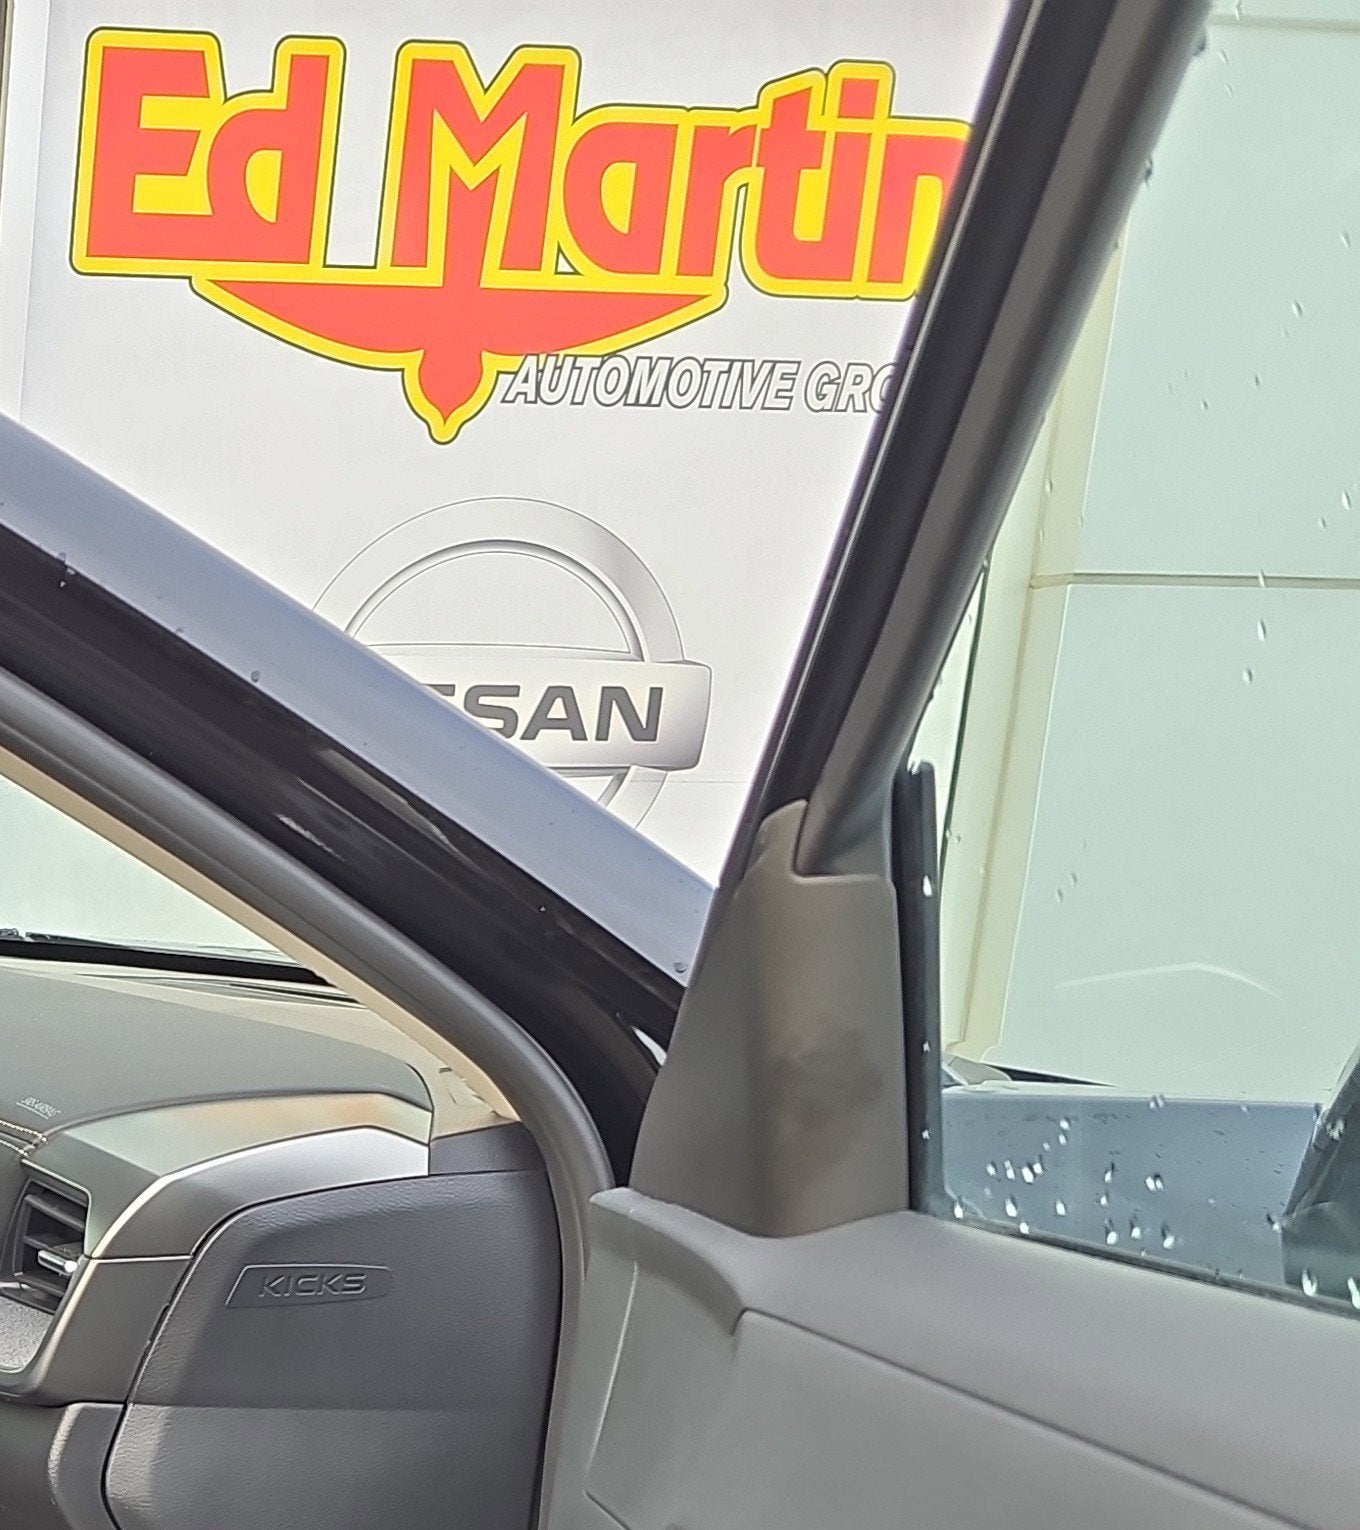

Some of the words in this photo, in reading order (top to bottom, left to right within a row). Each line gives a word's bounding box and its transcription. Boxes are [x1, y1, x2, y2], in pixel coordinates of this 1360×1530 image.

[72, 28, 345, 274] Ed
[500, 354, 801, 411] AUTOMOTIVE
[259, 1273, 367, 1298] KICKS
